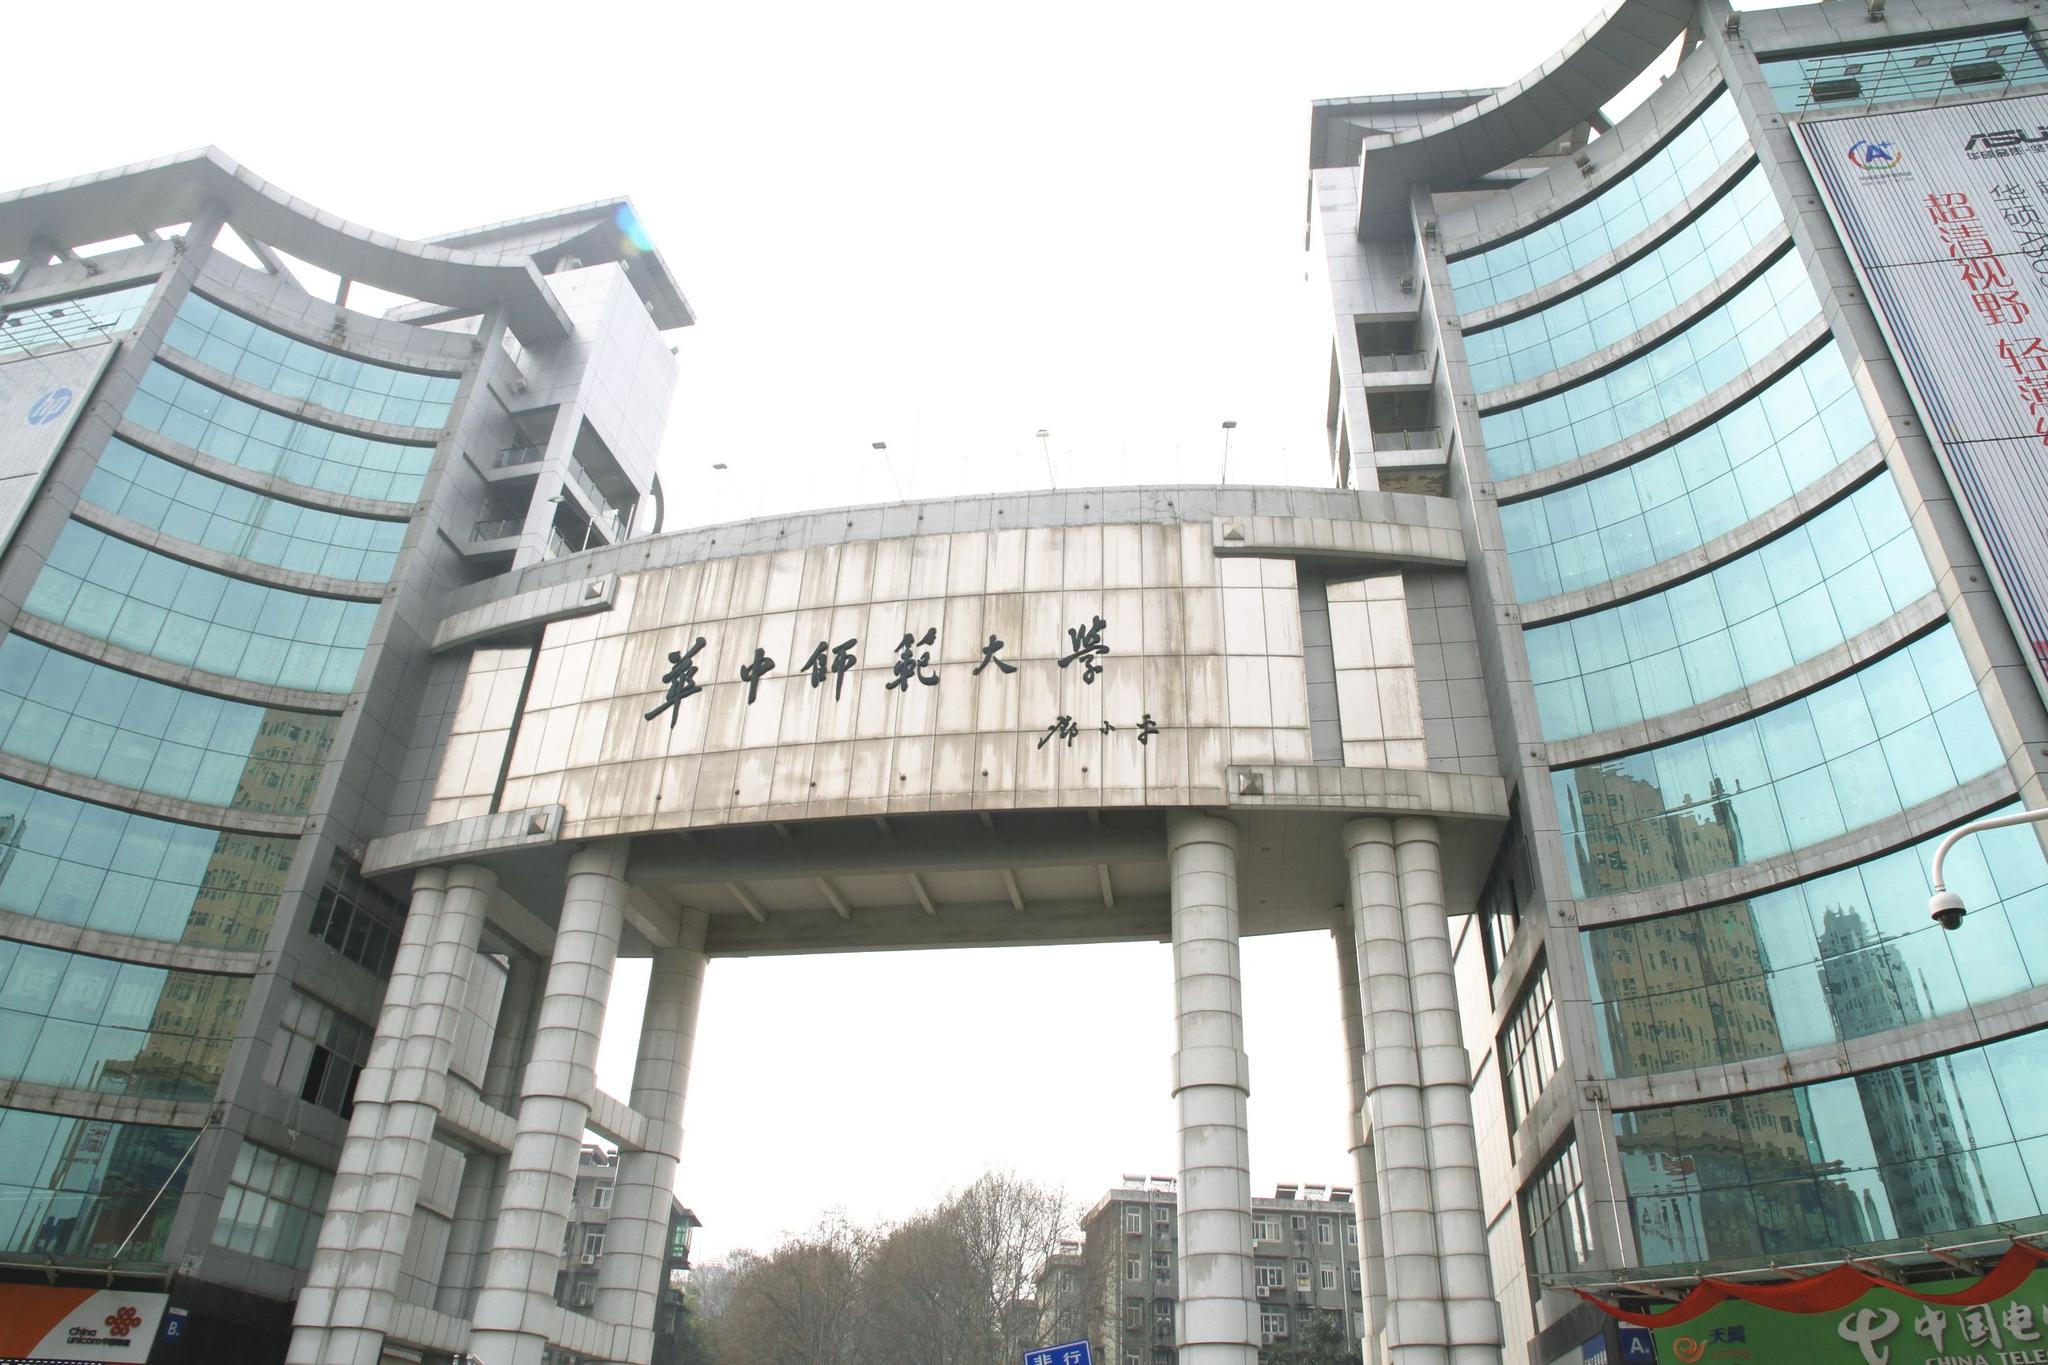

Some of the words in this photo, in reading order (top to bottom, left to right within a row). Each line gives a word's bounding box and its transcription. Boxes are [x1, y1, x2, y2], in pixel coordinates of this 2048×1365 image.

[1964, 126, 2048, 151] ASU
[1923, 192, 2029, 326] 超清视野
[69, 1327, 97, 1337] China
[1914, 1301, 2048, 1353] 中国电
[1997, 1349, 2048, 1365] TELE
